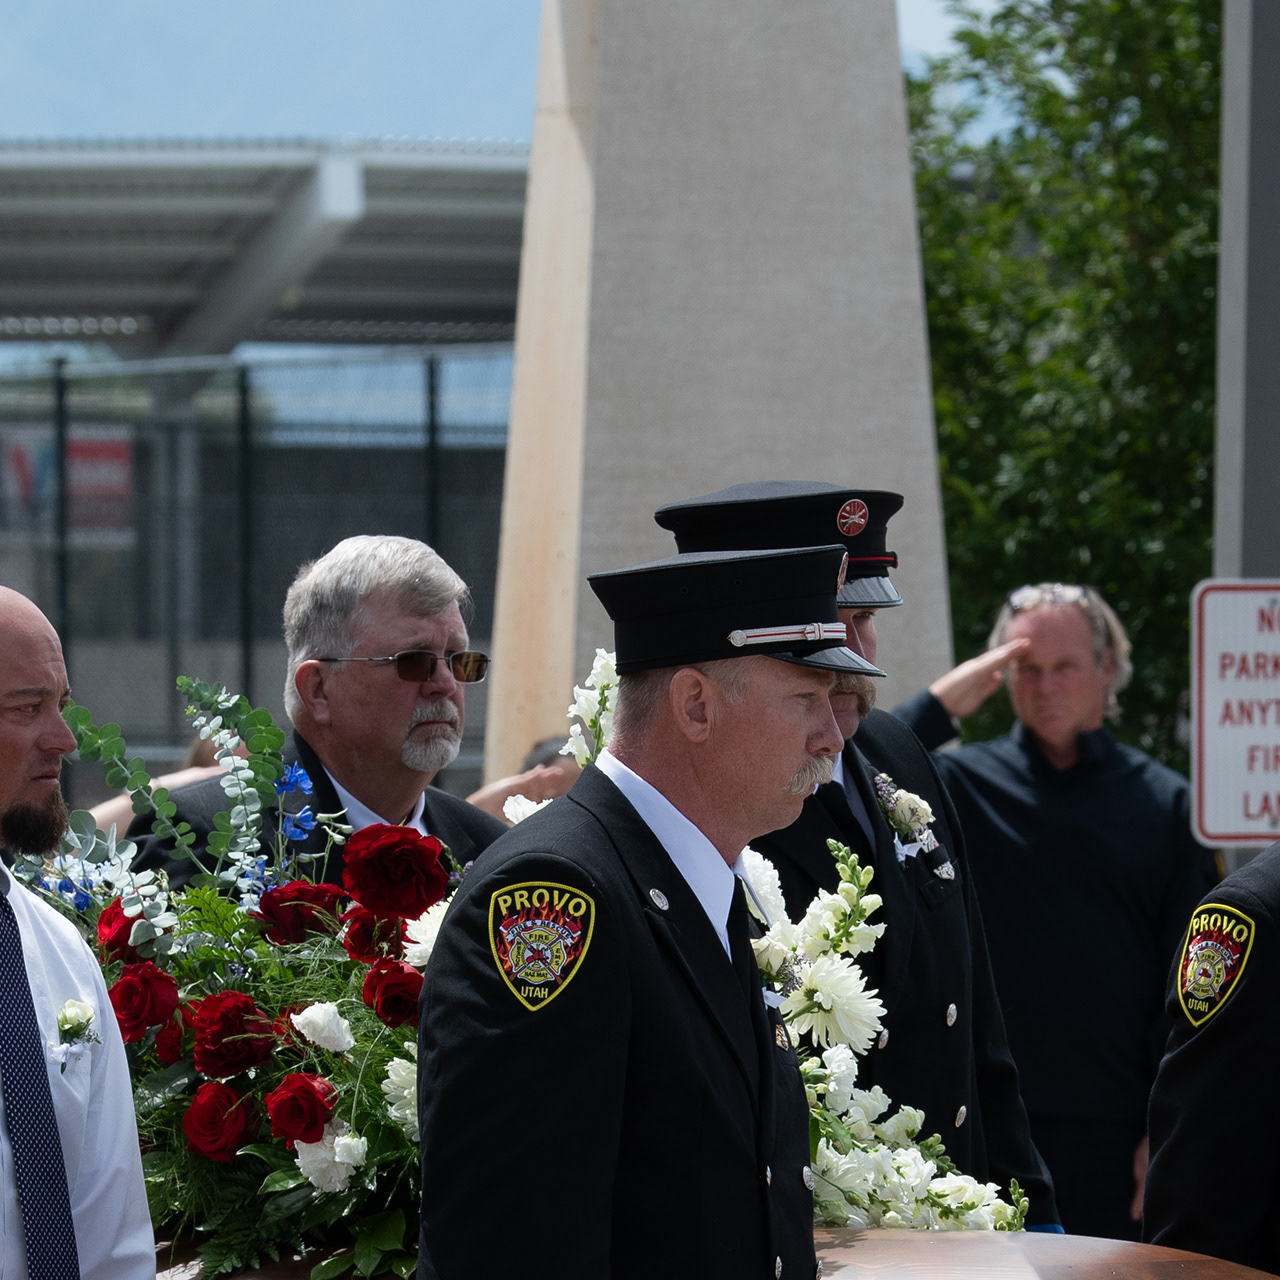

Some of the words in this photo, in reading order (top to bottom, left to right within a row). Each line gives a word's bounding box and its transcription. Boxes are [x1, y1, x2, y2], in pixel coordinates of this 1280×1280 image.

[497, 888, 587, 917] PROVO
[540, 920, 573, 939] RESCUE
[1193, 913, 1248, 942] PROVO
[521, 986, 549, 998] UTAH
[1188, 998, 1209, 1012] UTAH
